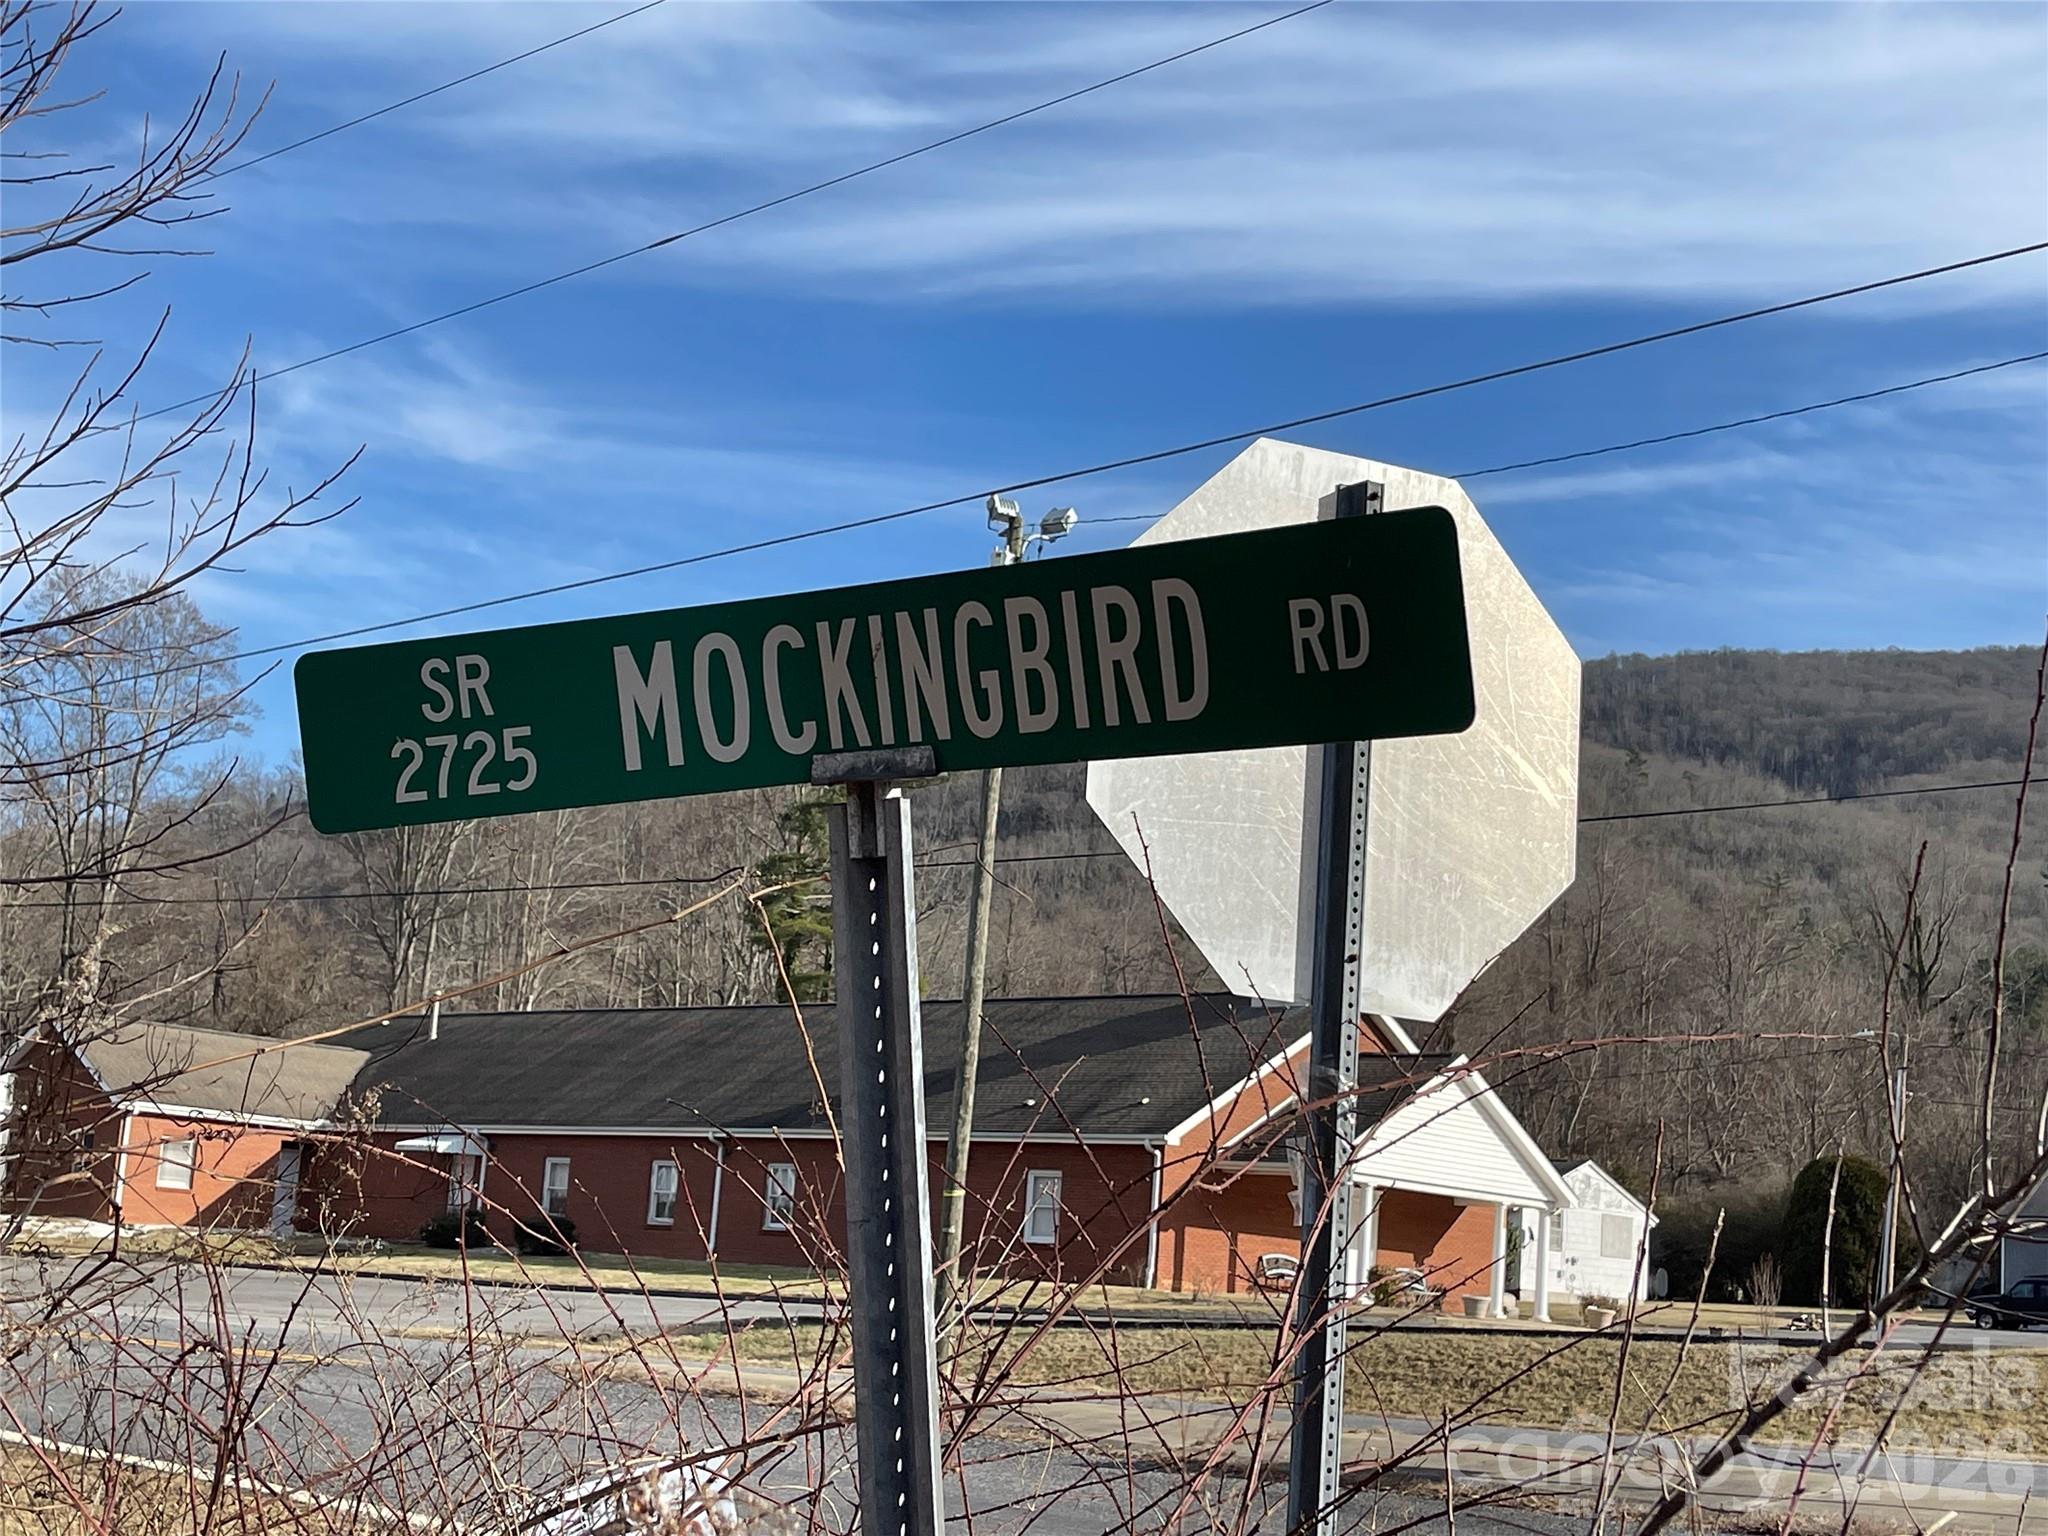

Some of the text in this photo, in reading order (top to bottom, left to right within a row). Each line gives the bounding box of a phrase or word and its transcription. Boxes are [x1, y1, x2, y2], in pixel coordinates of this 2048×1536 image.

[420, 654, 495, 724] SR
[612, 577, 1370, 772] MOCKINGBIRD RD
[390, 725, 537, 805] 2725
